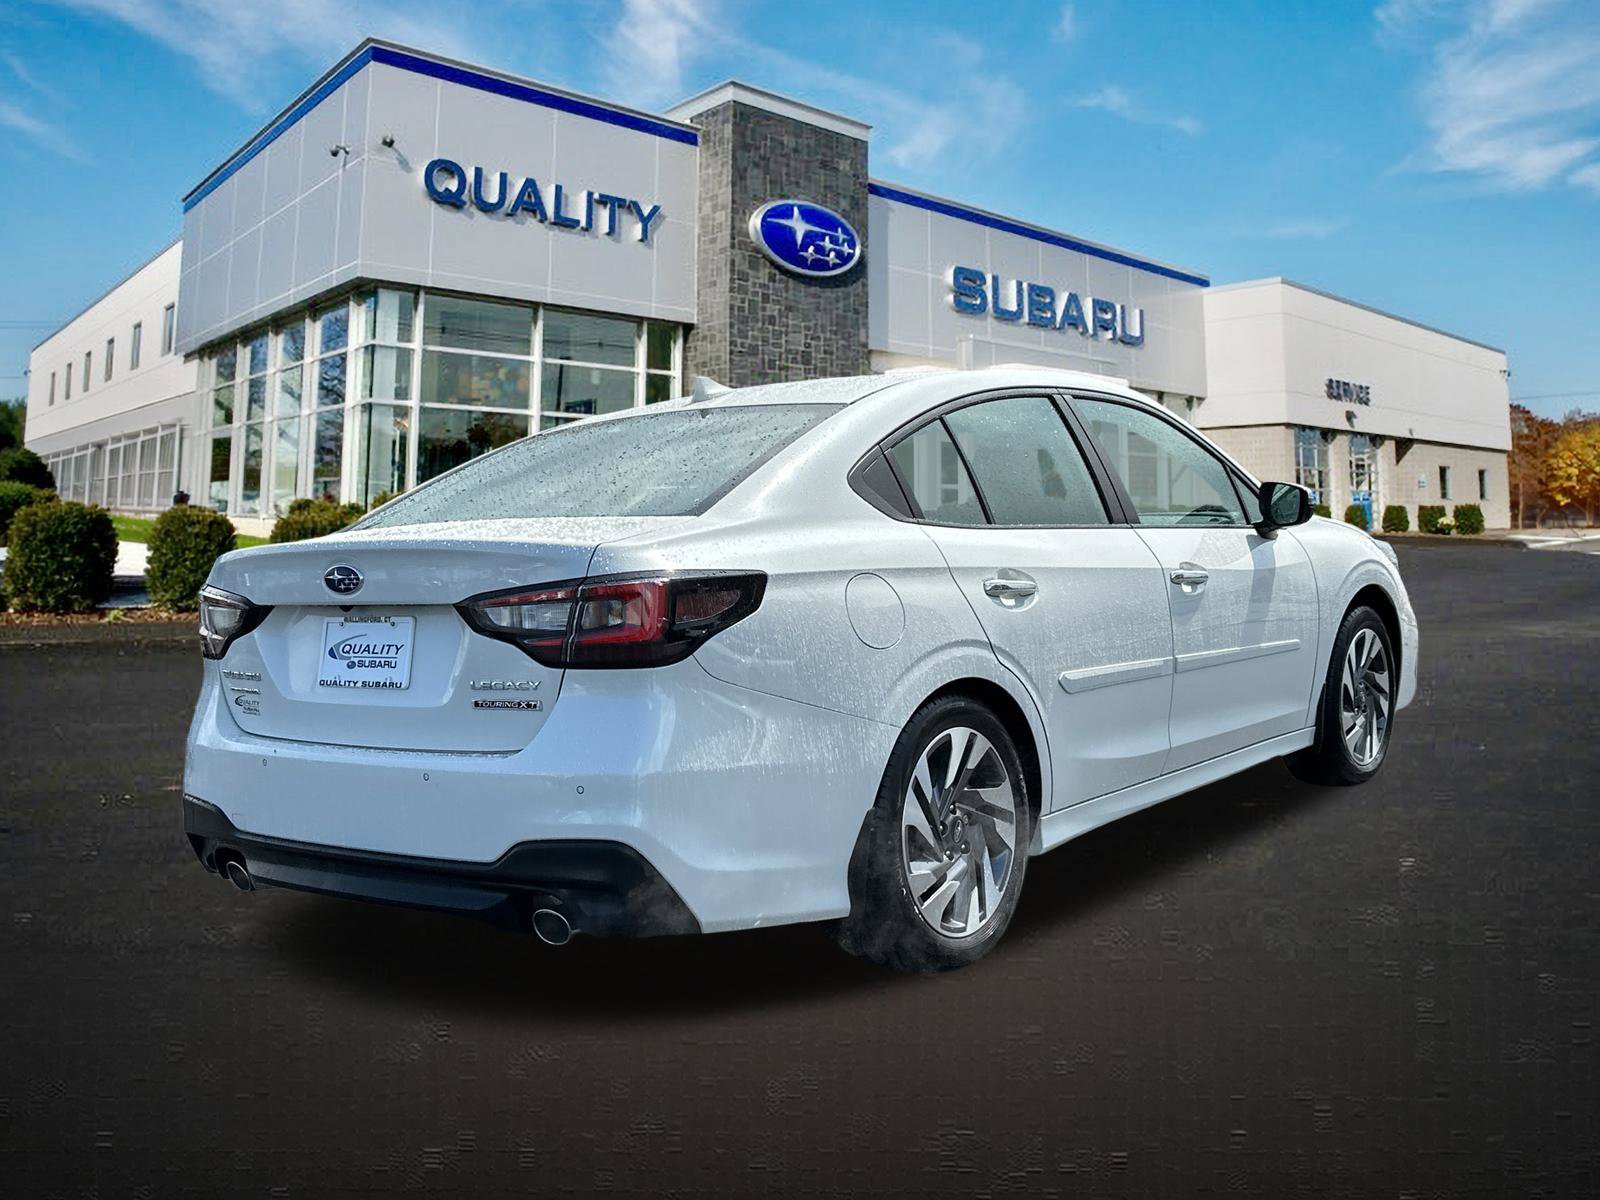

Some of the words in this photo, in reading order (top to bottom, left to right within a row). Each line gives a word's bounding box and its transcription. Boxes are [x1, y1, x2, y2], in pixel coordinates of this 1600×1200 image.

[423, 158, 662, 243] QUALITY
[949, 265, 1145, 346] SUBARU
[1325, 378, 1371, 406] SERVICE
[341, 643, 404, 655] QUALITY
[357, 660, 397, 669] SUBARU
[319, 679, 359, 688] QUALITY
[361, 680, 403, 689] SUBARU
[470, 680, 542, 690] LEGACY
